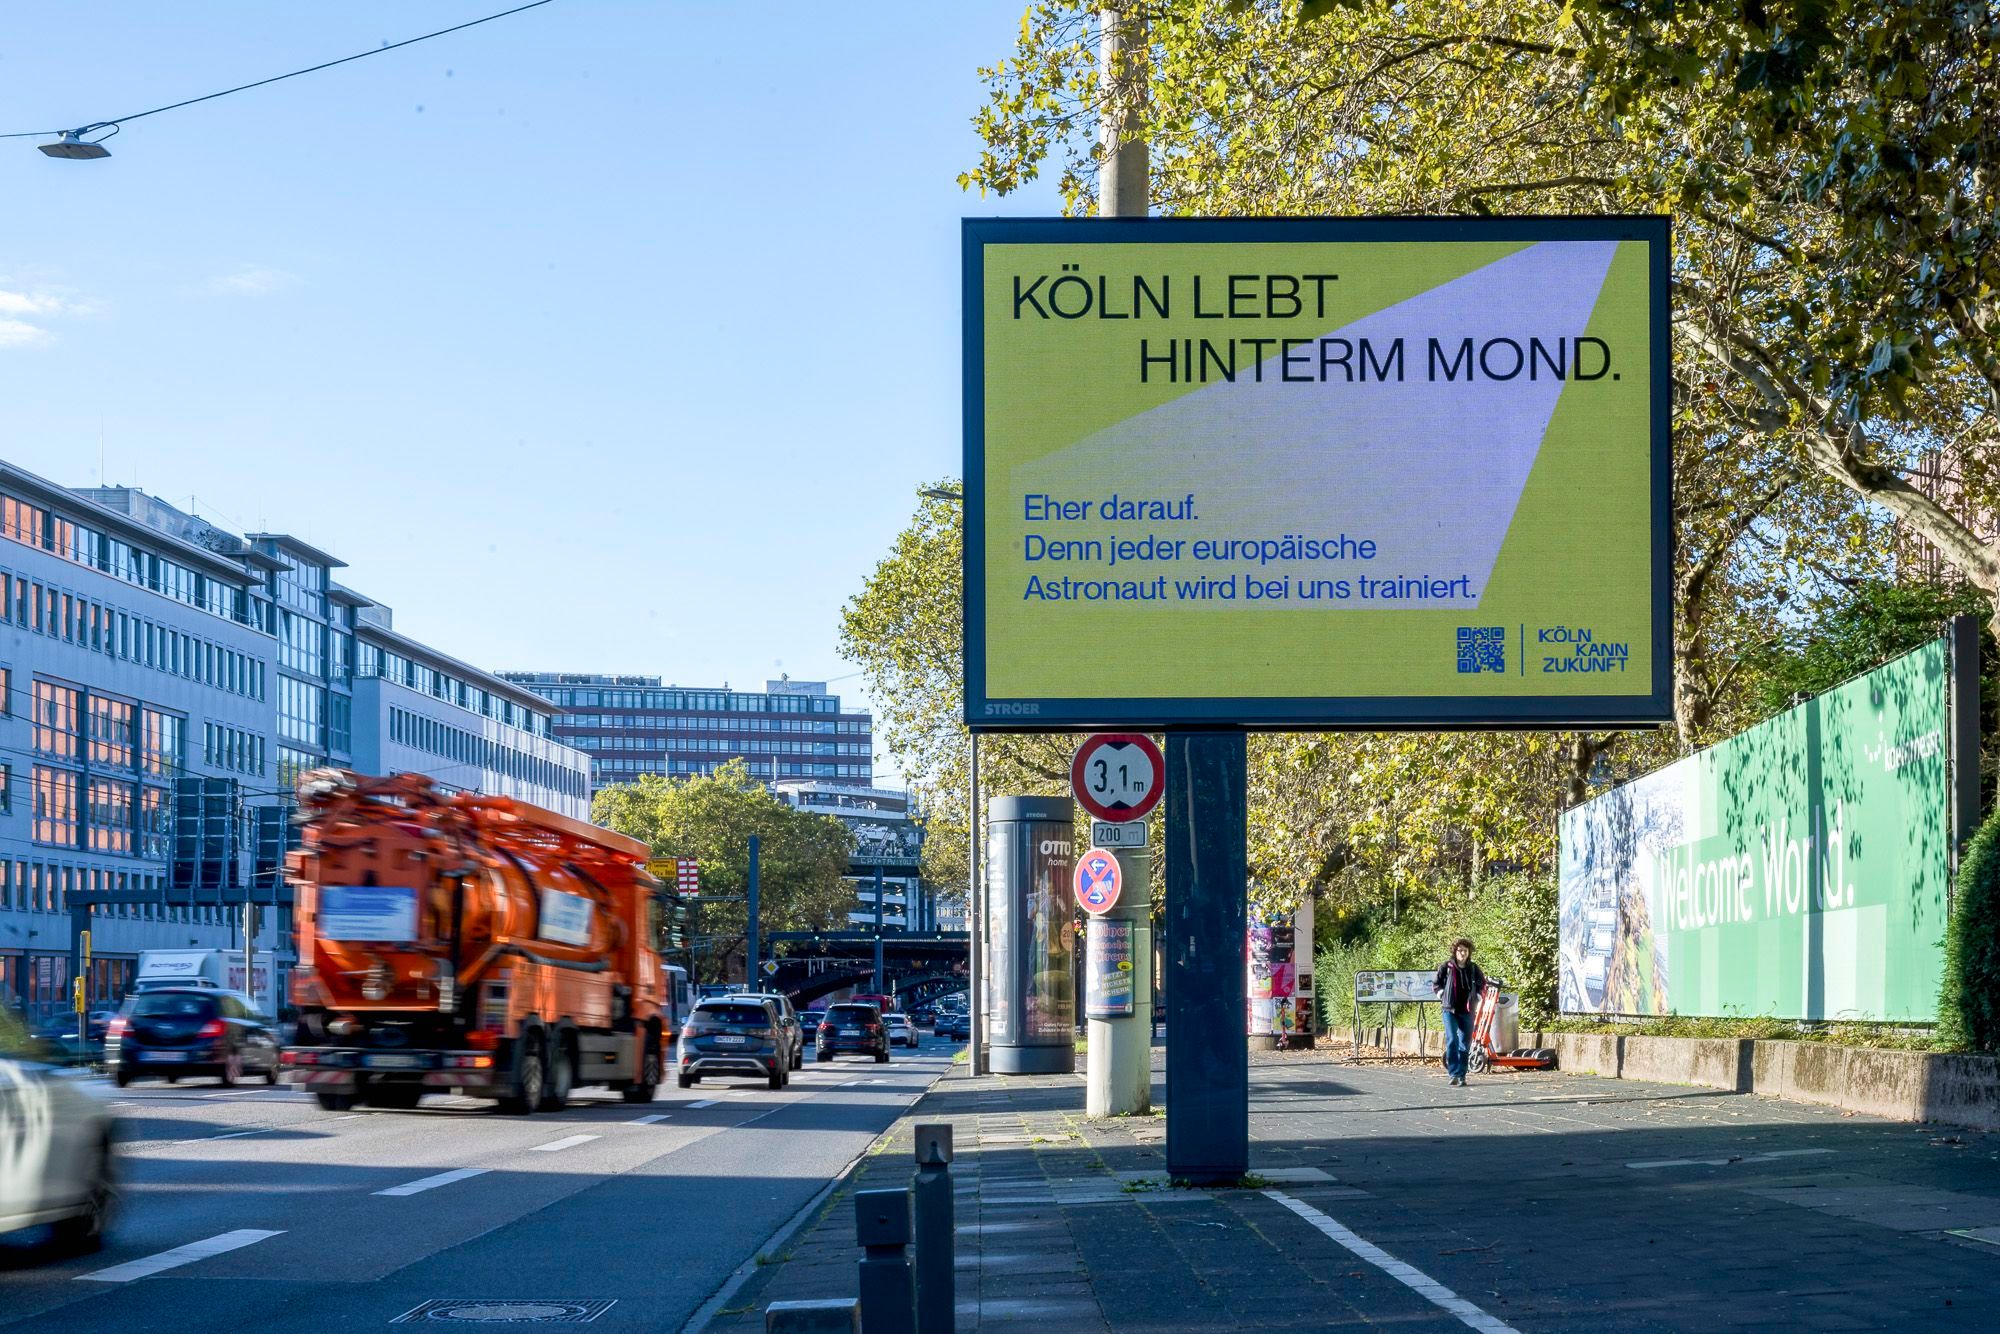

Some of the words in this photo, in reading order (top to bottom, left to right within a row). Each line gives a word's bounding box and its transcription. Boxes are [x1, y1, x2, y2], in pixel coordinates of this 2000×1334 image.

[1012, 264, 1171, 319] KÖLN
[1193, 274, 1339, 319] LEBT
[1140, 337, 1405, 383] HINTERM
[1428, 336, 1621, 382] MOND.
[1024, 495, 1093, 521] Eher
[1100, 494, 1199, 521] darauf.
[1024, 535, 1101, 561] Denn
[1108, 534, 1186, 566] jeder
[1193, 532, 1377, 566] europäische
[1023, 574, 1168, 600] Astronaut
[1175, 574, 1238, 600] wird
[1245, 573, 1290, 600] bei
[1298, 580, 1350, 600] uns
[1358, 574, 1477, 600] trainiert.
[1538, 626, 1592, 643] KÖLN
[1576, 643, 1628, 657] KANN
[1543, 657, 1629, 673] ZUKUNFT
[985, 702, 1040, 715] STRÖER
[1093, 759, 1128, 795] 3,1
[1098, 827, 1121, 842] 200
[1040, 840, 1072, 856] OTTO
[1047, 857, 1069, 867] home
[1659, 842, 1754, 932] Welcome
[1761, 798, 1855, 918] World.
